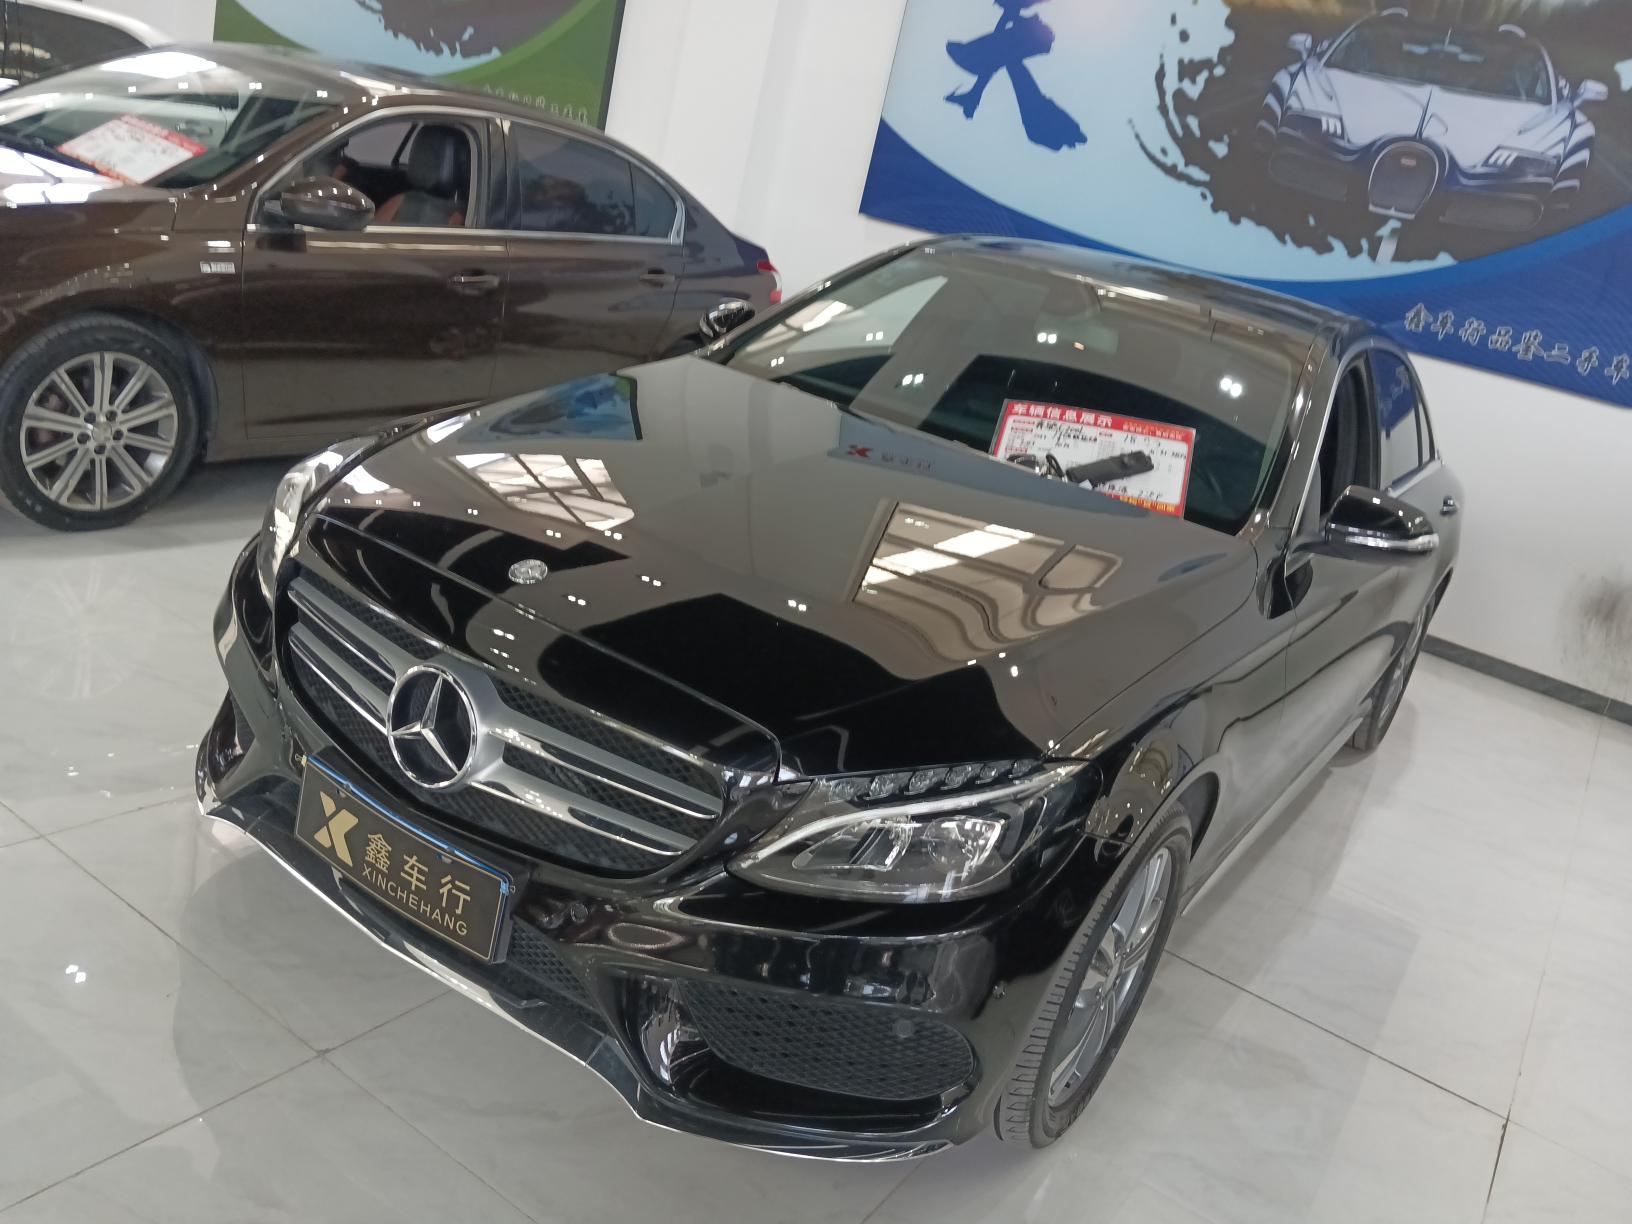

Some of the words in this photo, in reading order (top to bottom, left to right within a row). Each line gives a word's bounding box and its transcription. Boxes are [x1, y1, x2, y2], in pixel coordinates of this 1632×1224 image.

[362, 864, 468, 937] XINCHEHANG
[364, 833, 471, 915] 鑫车行
